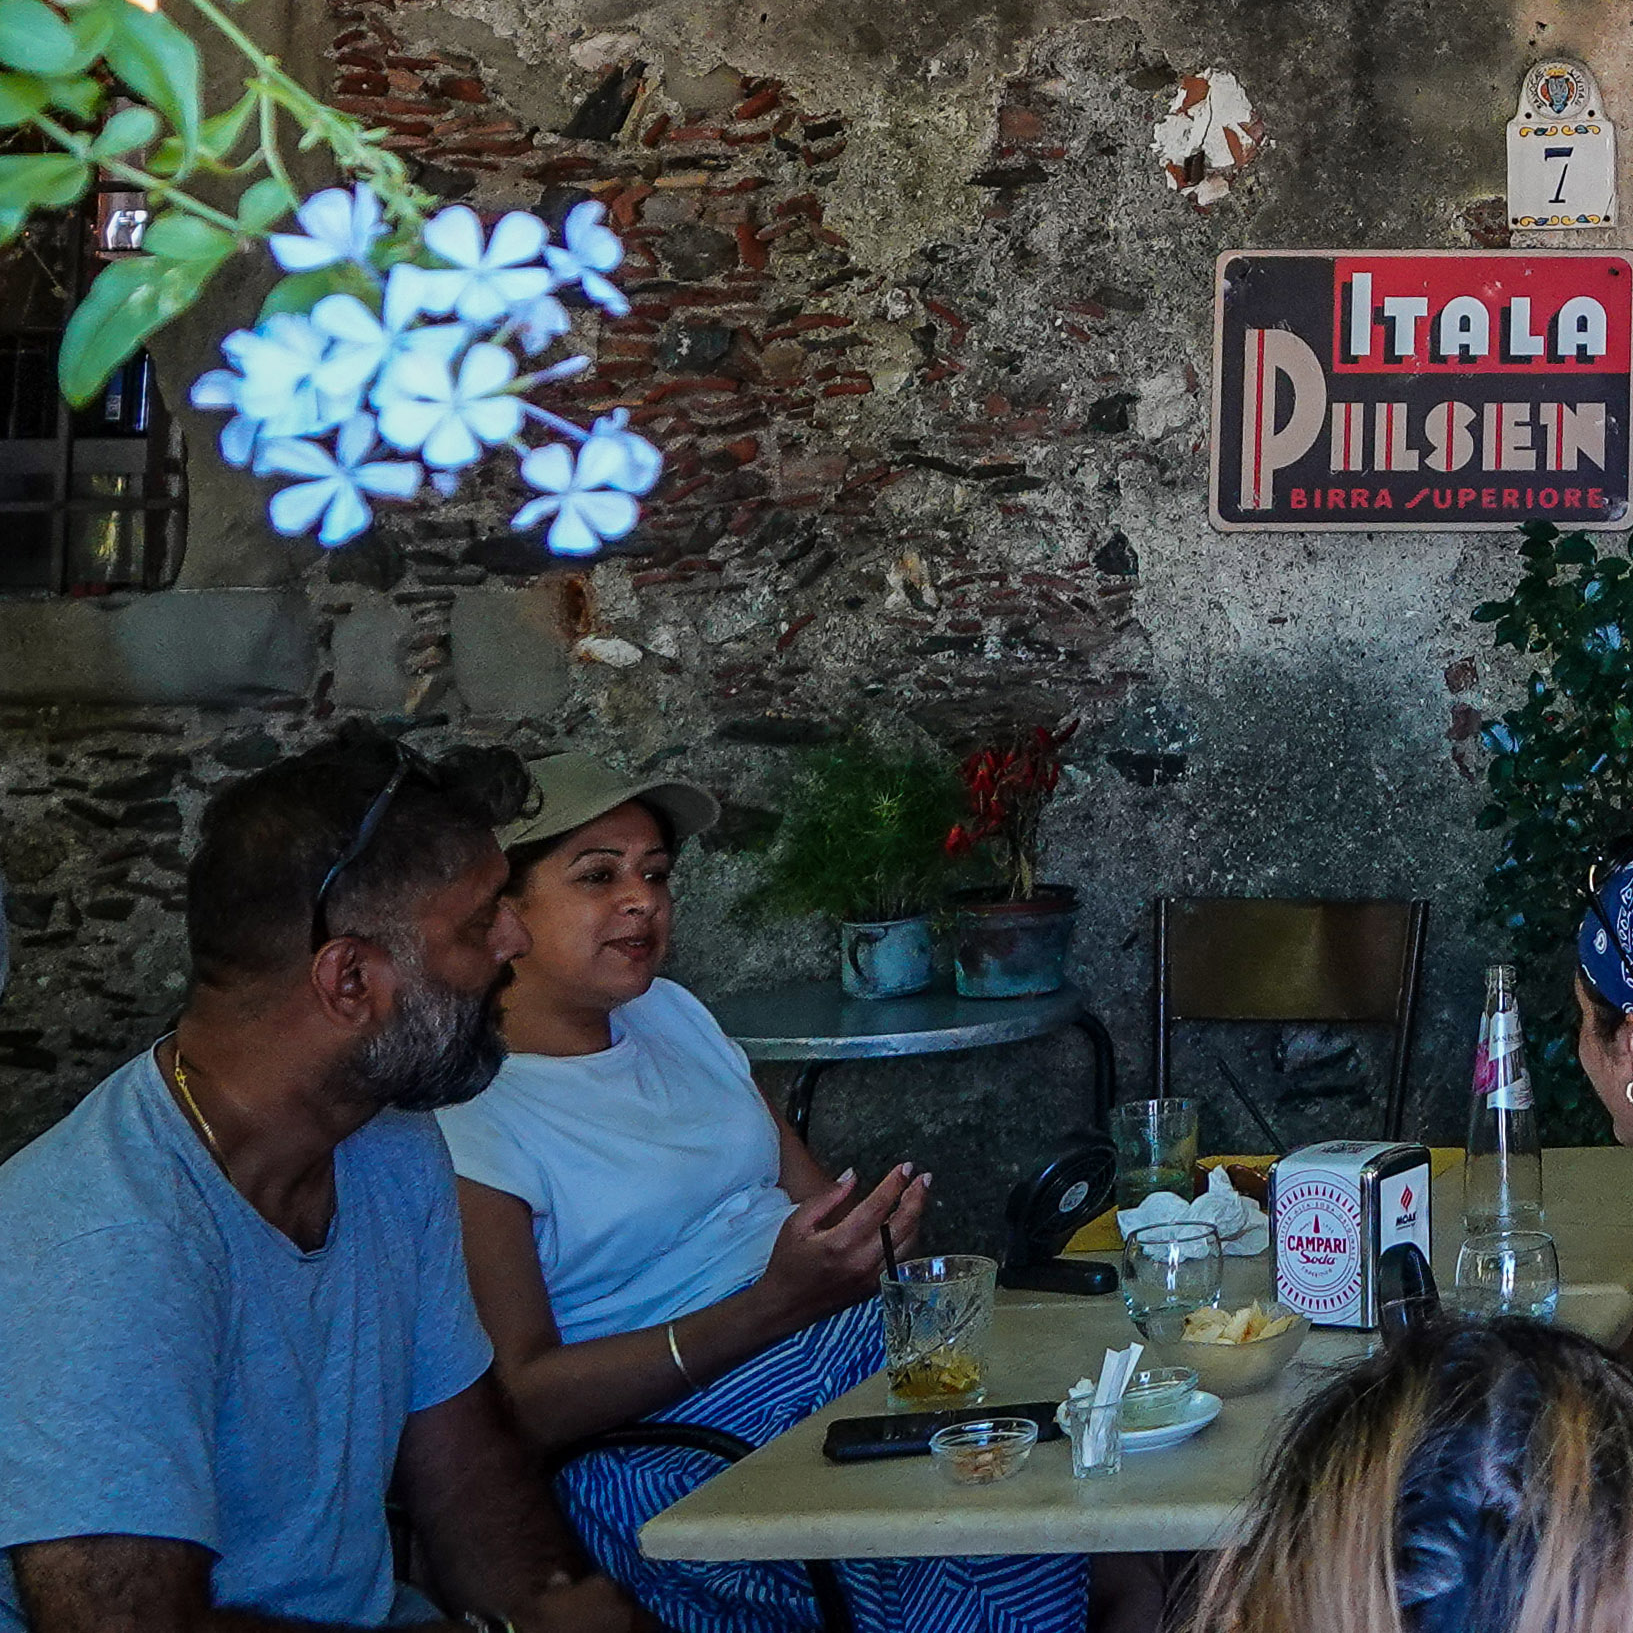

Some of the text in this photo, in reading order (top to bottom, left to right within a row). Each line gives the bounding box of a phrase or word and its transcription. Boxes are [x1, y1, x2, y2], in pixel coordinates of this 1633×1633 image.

[1544, 146, 1574, 204] 7
[1349, 272, 1608, 357] ITALA
[1239, 327, 1607, 511] PILSEN
[1289, 487, 1604, 510] BIRRA SUPERIORE
[1287, 1234, 1347, 1255] CAMPARI
[1297, 1249, 1337, 1266] Soda
